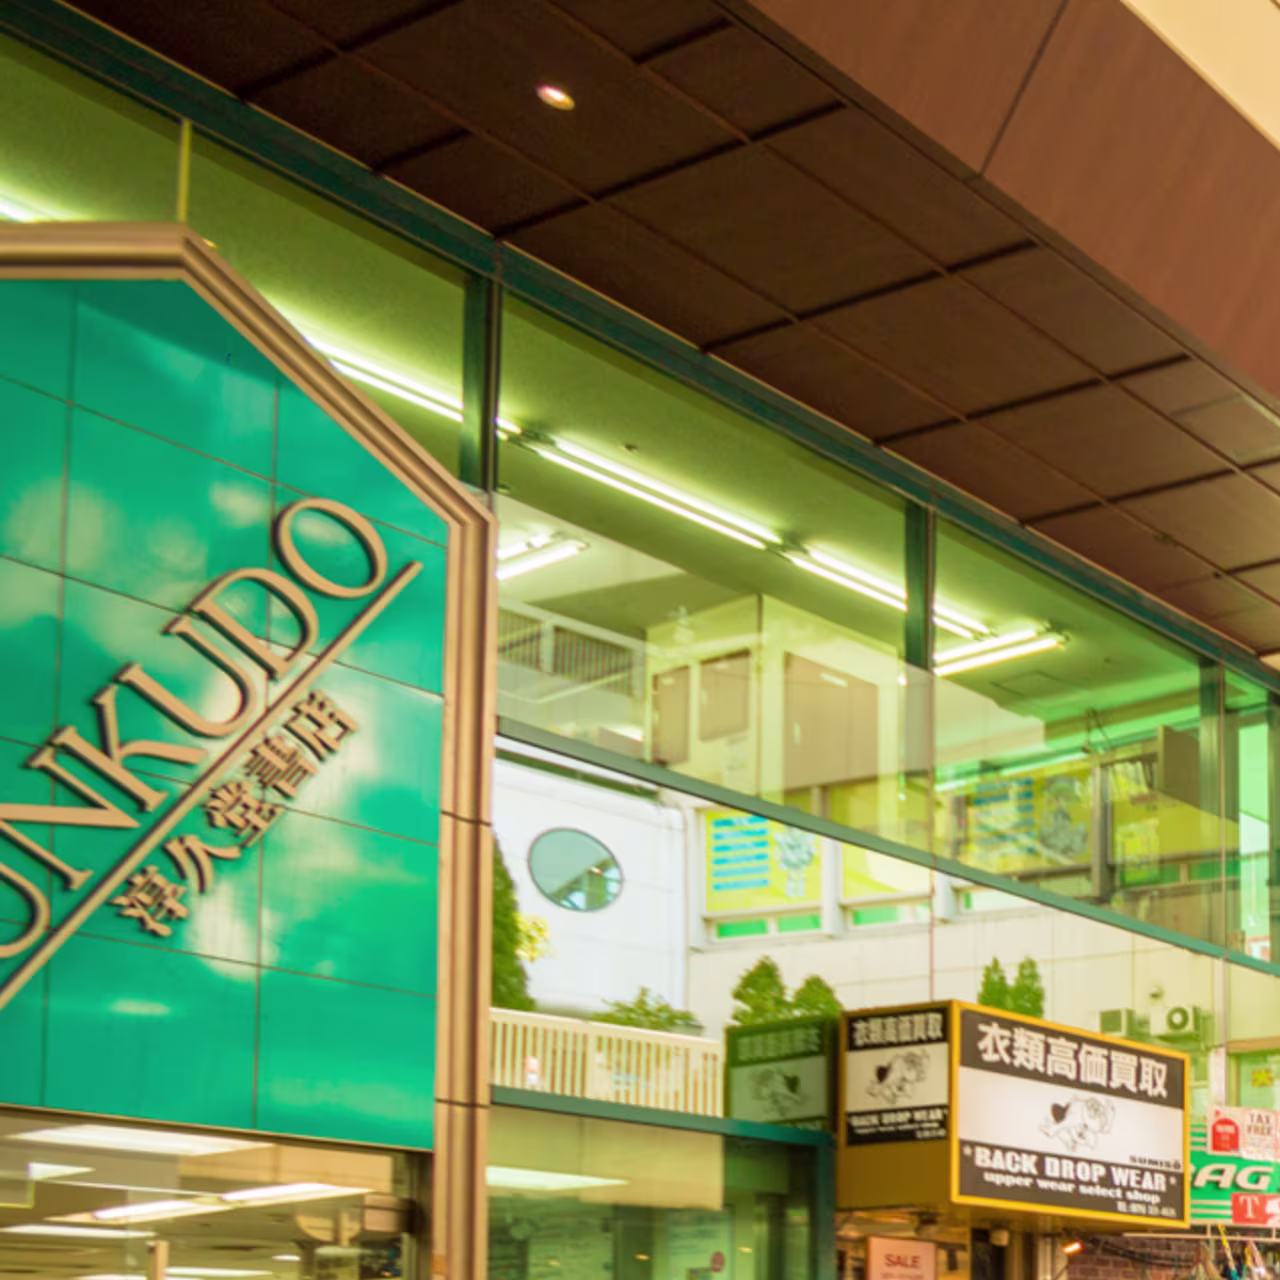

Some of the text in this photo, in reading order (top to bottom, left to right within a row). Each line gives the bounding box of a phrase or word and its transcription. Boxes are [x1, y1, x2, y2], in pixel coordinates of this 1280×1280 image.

[976, 1021, 1168, 1098] 衣類高価買取
[1247, 1125, 1273, 1137] FREE
[1249, 1112, 1272, 1125] TAX
[974, 1146, 1167, 1193] BACK DROP WEAR
[1189, 1162, 1274, 1193] AG
[983, 1171, 1161, 1206] upper wear select shop
[884, 1253, 921, 1270] SALE
